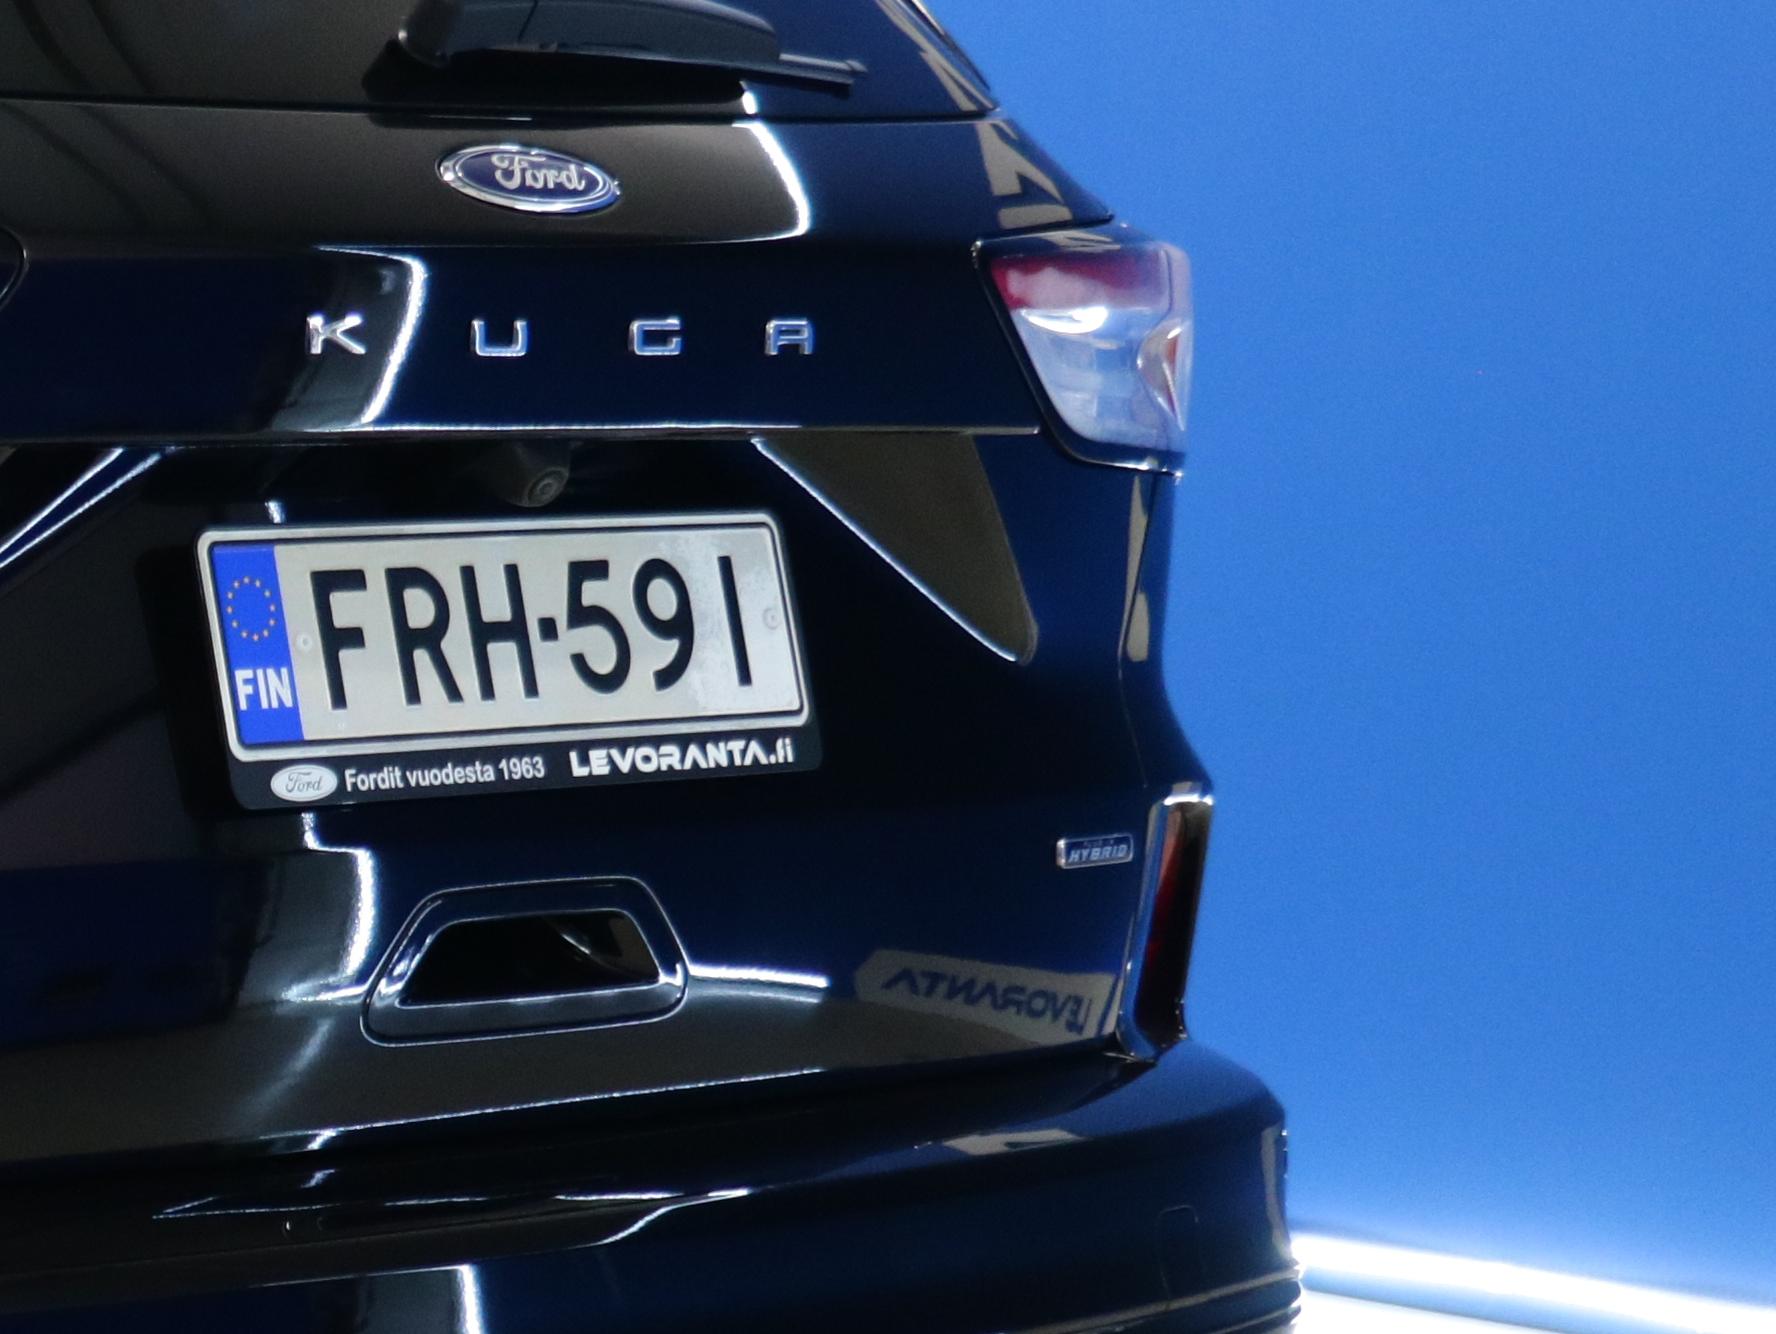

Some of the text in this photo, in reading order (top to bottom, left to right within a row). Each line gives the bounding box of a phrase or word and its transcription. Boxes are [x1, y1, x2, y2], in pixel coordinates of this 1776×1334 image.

[490, 153, 586, 192] Ford
[306, 313, 814, 358] KUGA
[309, 554, 754, 712] FRH-591
[234, 666, 295, 711] FIN
[344, 755, 546, 793] Fordit vuodesta 1963
[568, 736, 795, 778] LEVORANTA.fi
[285, 771, 324, 794] Ford
[1067, 843, 1129, 864] HYBRID
